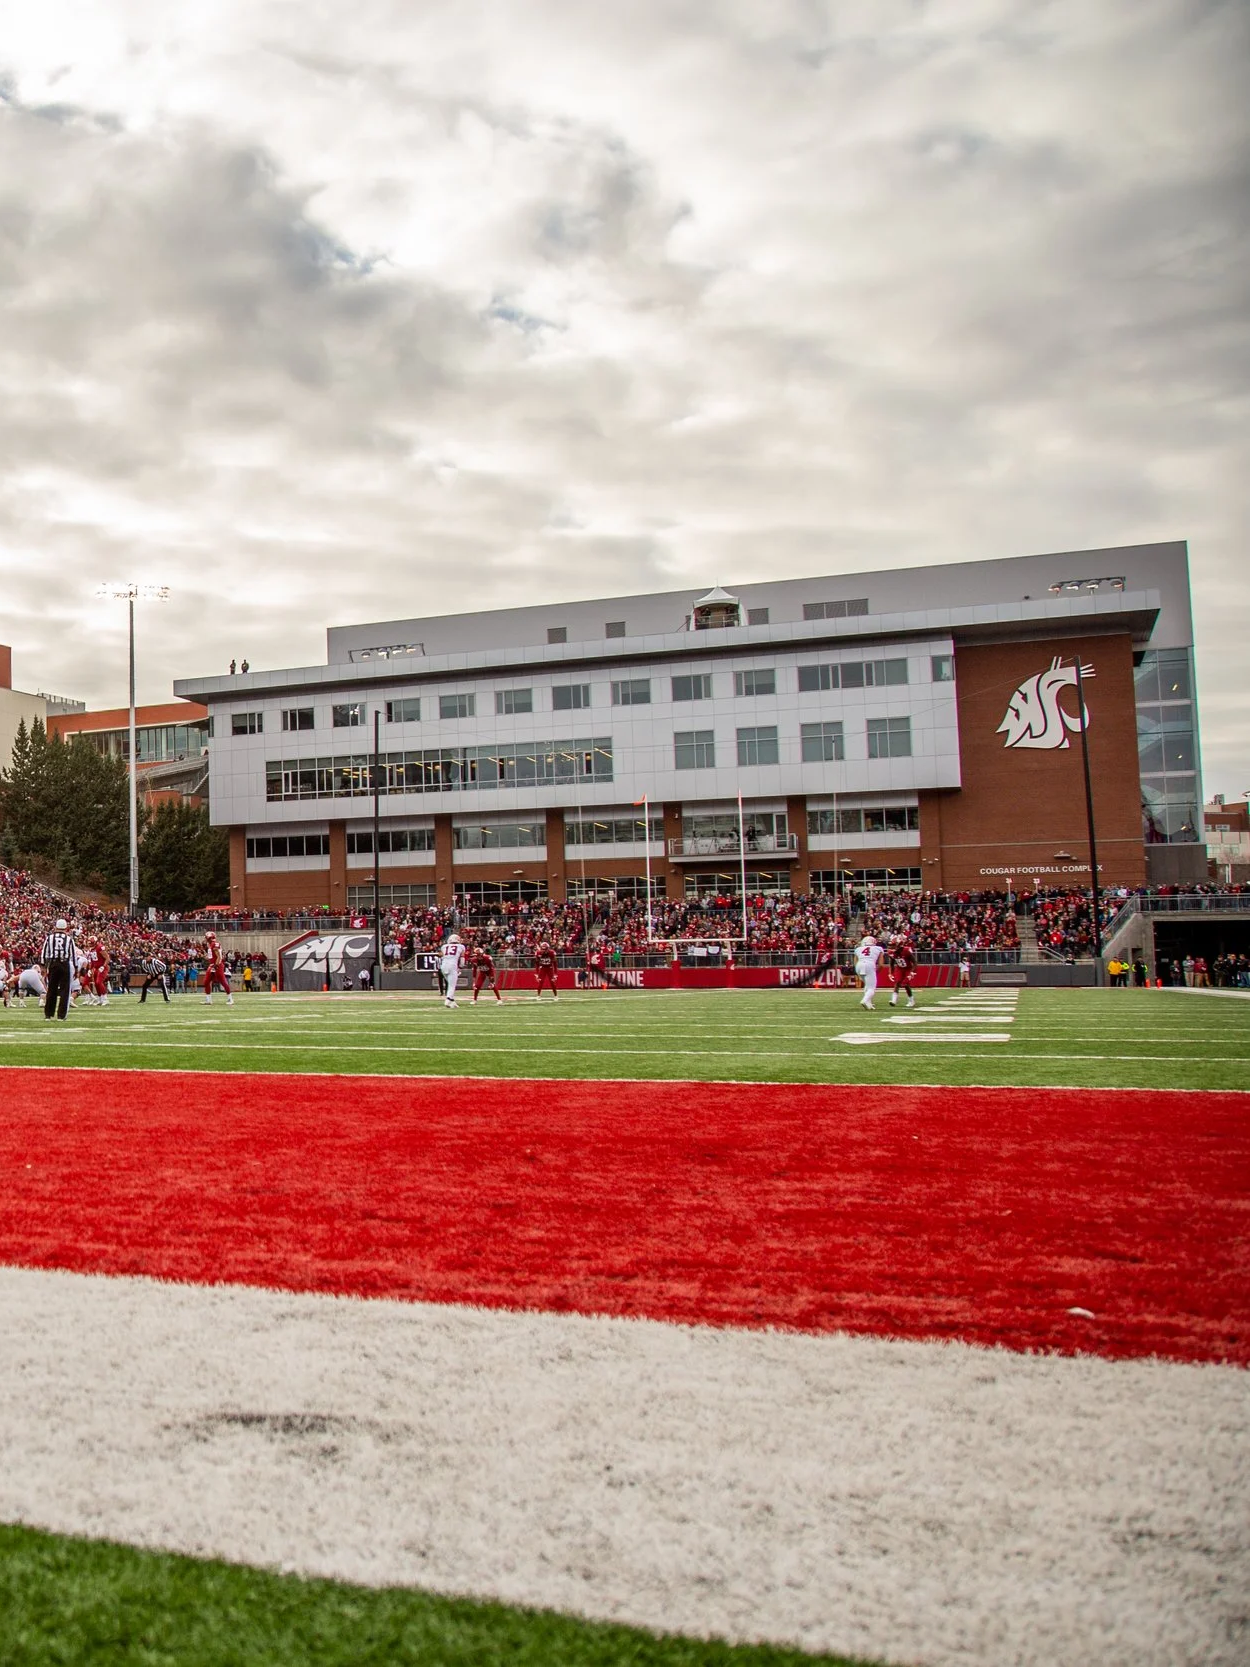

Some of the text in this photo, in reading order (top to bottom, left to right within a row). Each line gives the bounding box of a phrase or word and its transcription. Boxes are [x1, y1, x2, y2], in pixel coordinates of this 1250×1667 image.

[55, 939, 64, 950] R
[444, 946, 457, 956] 13
[861, 947, 871, 956] 4
